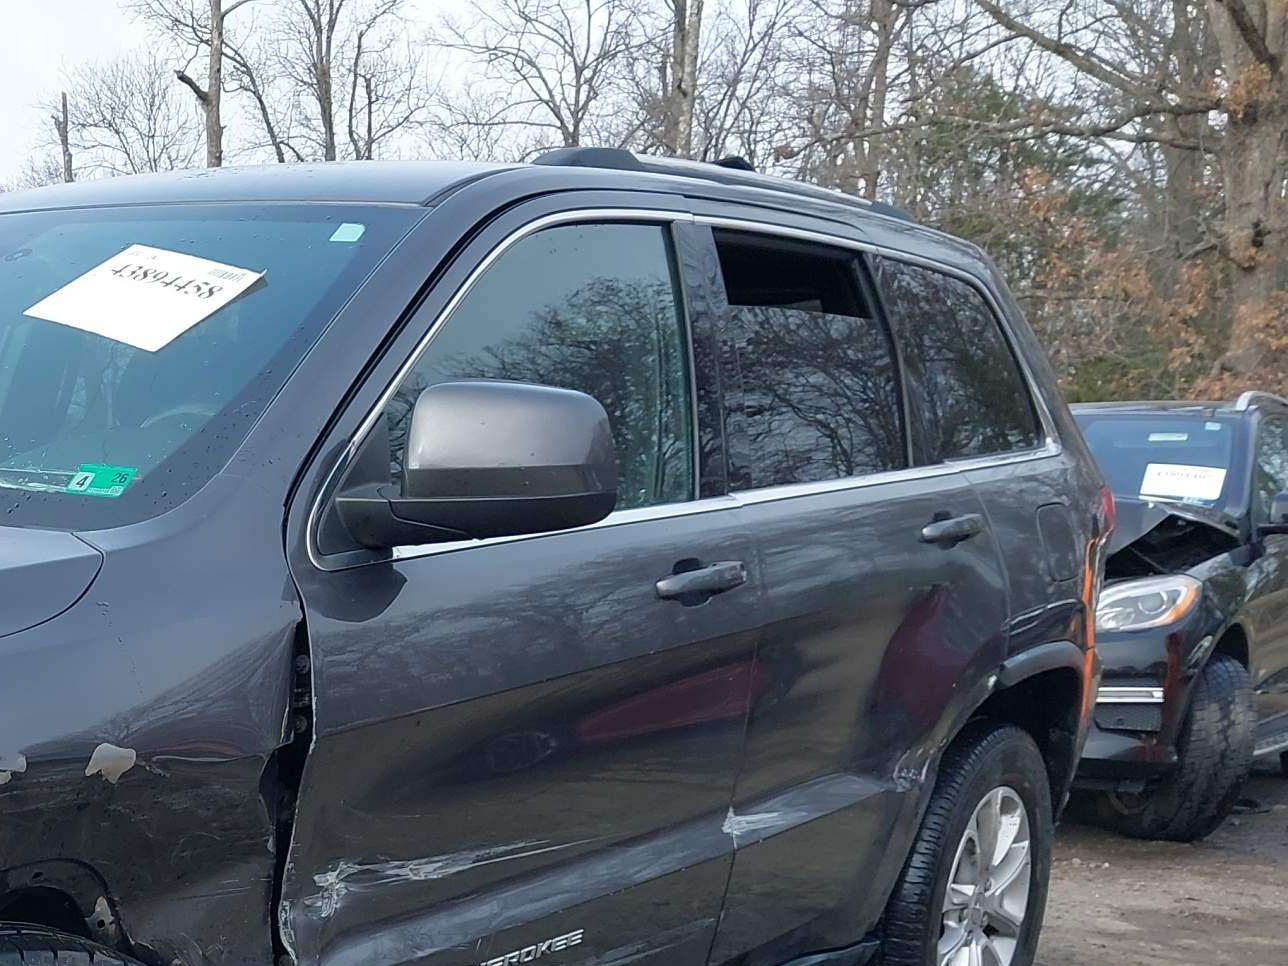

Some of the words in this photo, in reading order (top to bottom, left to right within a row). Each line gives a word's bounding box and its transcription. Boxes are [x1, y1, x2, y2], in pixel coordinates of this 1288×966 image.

[111, 263, 223, 300] 43894458
[76, 475, 90, 488] 4
[111, 472, 129, 484] 26
